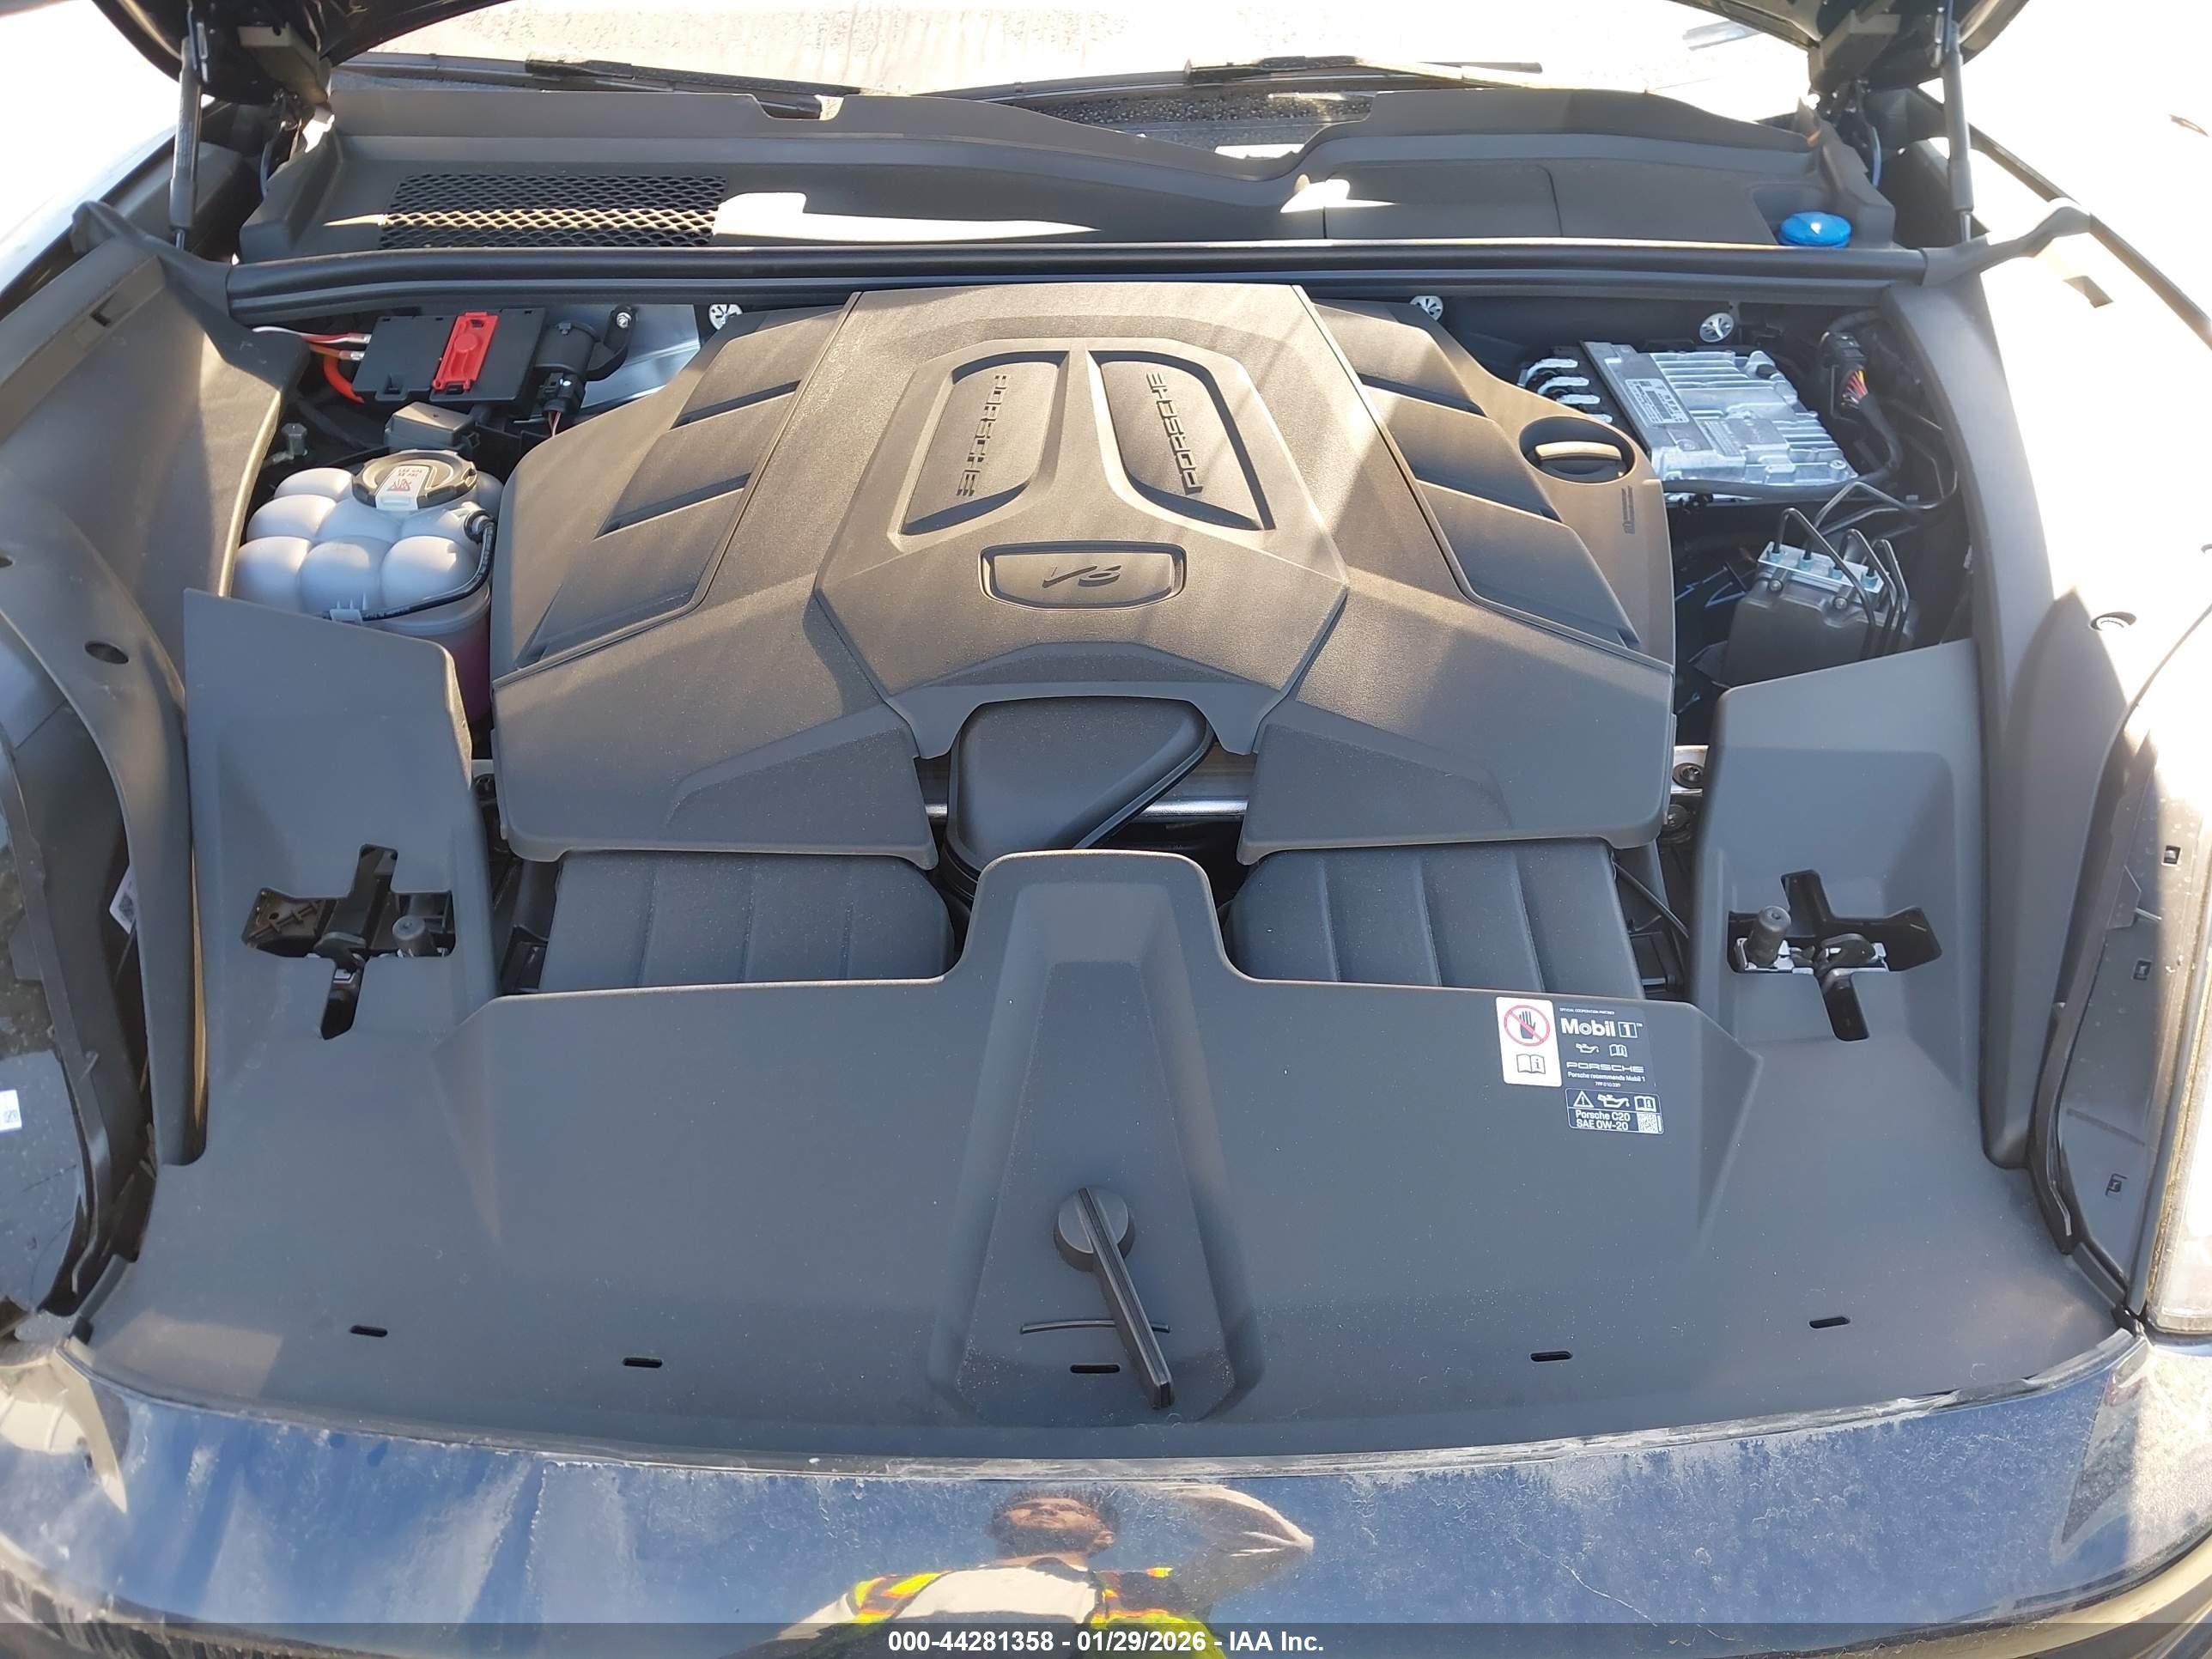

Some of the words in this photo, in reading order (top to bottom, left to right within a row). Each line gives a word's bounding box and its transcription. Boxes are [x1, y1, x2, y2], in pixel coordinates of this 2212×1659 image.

[956, 374, 1006, 495] PORSCHE
[1146, 372, 1203, 494] PORSCHE
[1042, 564, 1121, 588] V6
[1560, 1018, 1616, 1037] Mobil
[1566, 1061, 1644, 1073] PORSCHE
[1575, 1109, 1610, 1120] Porsche
[1611, 1111, 1631, 1121] C20
[1577, 1119, 1595, 1128] SAE
[1595, 1120, 1629, 1131] 0W-20
